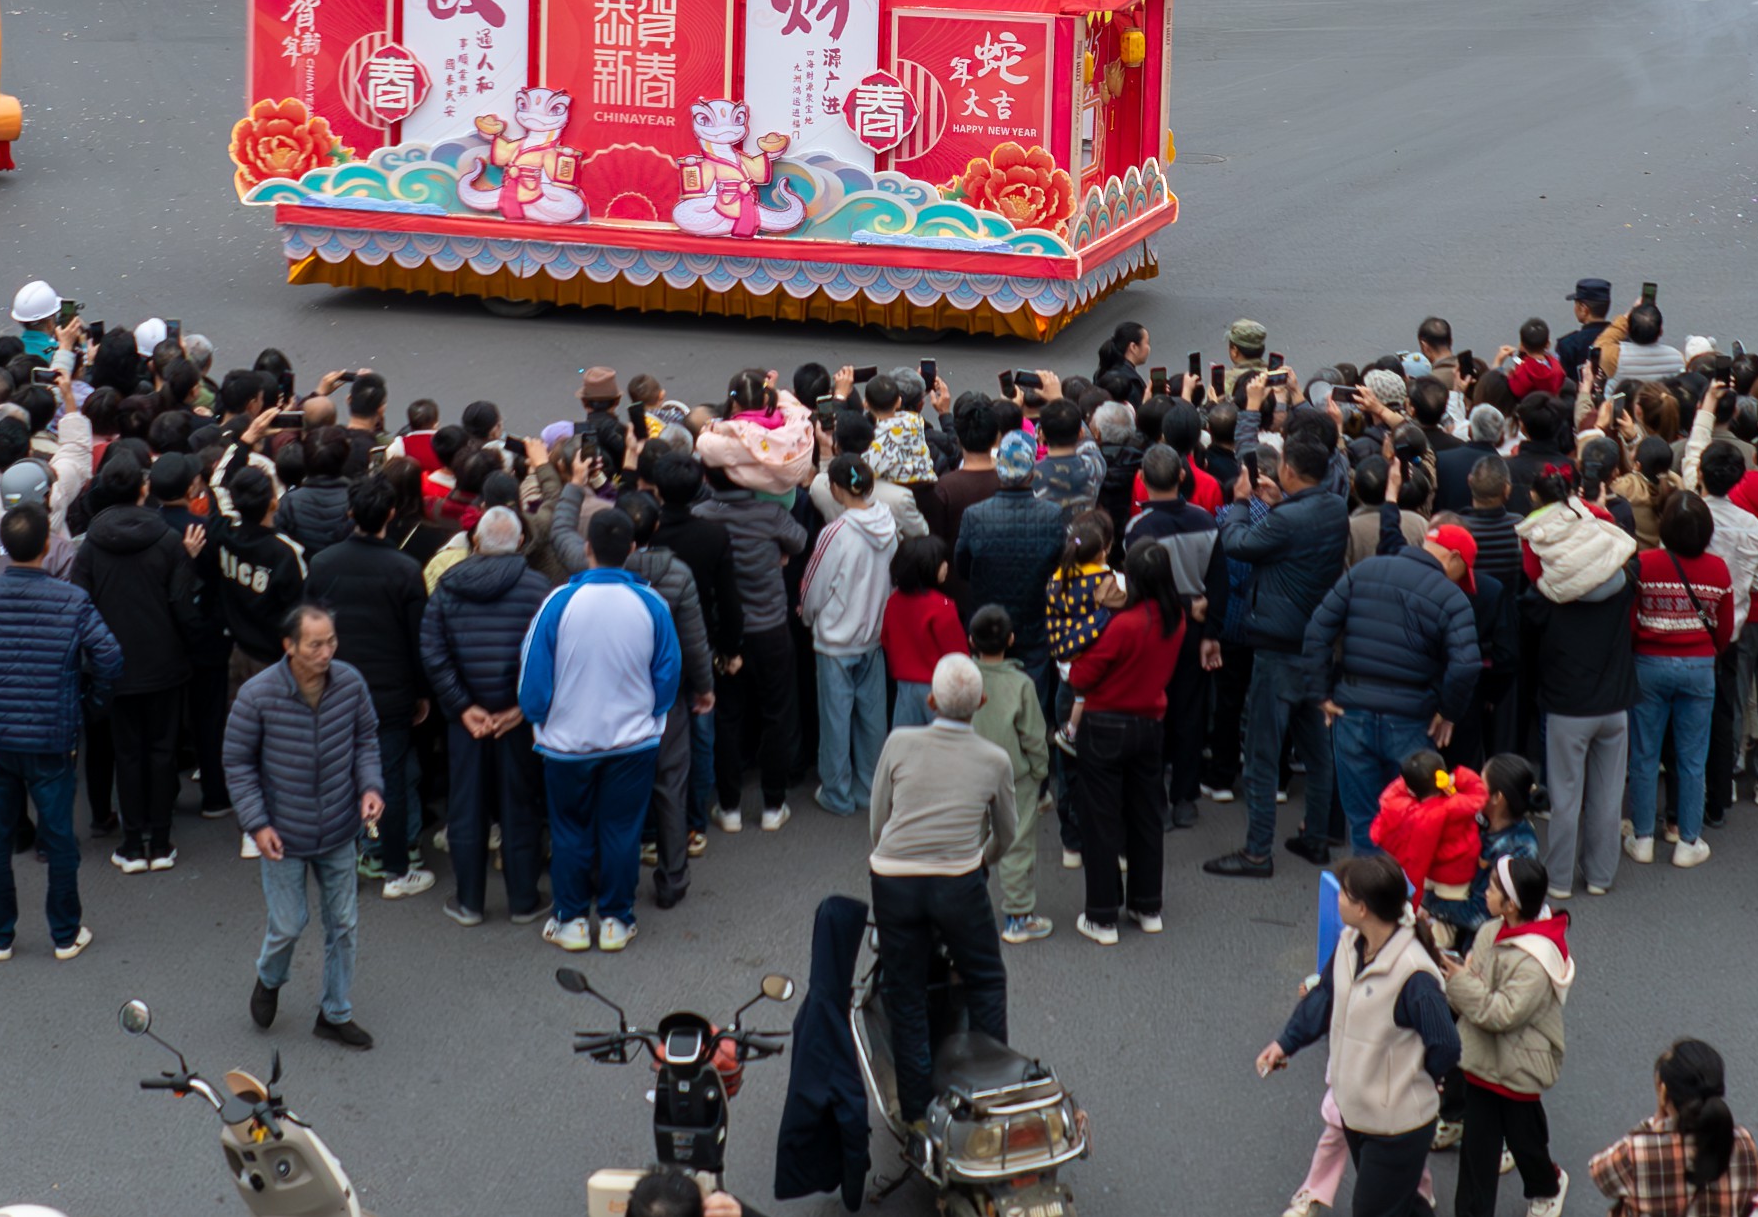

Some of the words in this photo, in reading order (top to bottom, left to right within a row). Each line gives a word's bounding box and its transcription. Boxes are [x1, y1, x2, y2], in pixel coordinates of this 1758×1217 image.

[476, 28, 494, 95] 通人和
[822, 48, 841, 115] 源广进
[594, 110, 676, 127] CHINAYEAR
[960, 88, 1015, 121] 大吉
[953, 124, 984, 135] HAPPY
[987, 126, 1011, 136] NEW
[1012, 127, 1037, 138] YEAR
